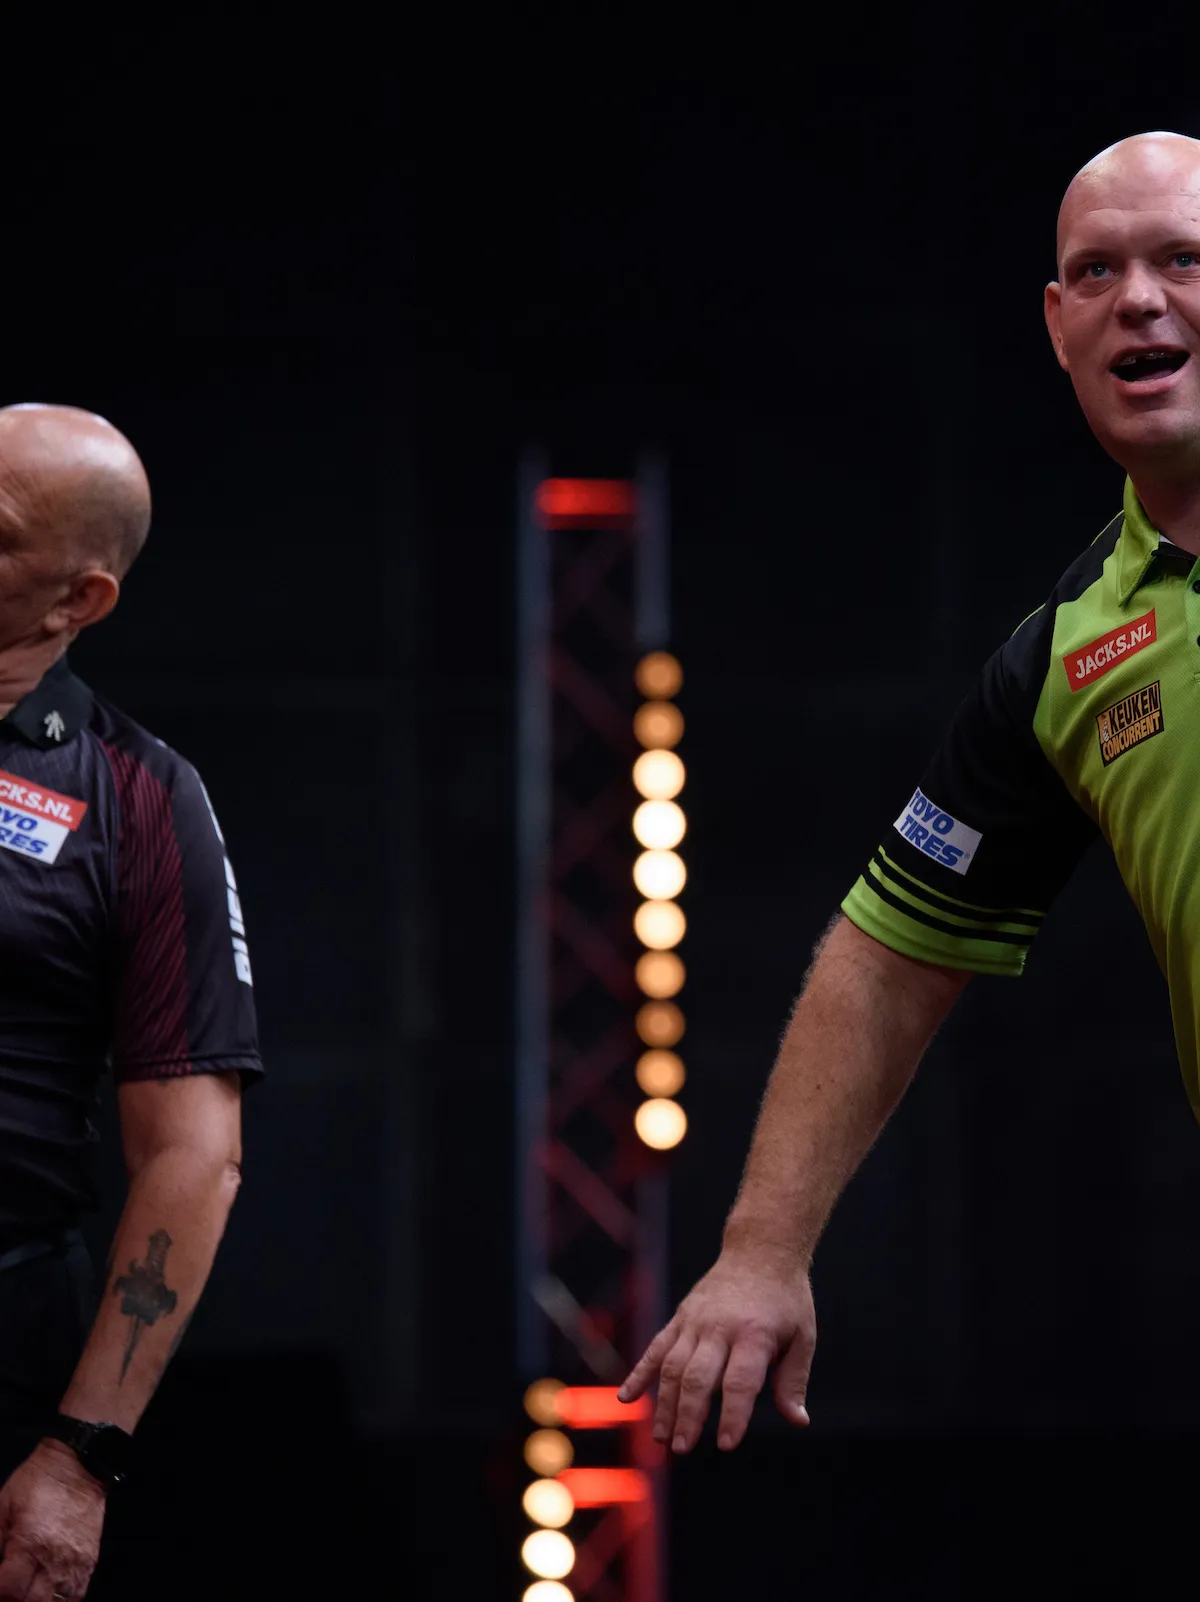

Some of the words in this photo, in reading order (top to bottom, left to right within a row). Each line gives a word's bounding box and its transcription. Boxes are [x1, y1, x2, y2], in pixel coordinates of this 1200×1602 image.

[1074, 623, 1152, 680] JACKS.NL
[1108, 684, 1159, 735] KEUKEN
[1102, 711, 1160, 761] CONCURRENT
[0, 806, 38, 831] YO
[908, 789, 955, 835] TOYO
[899, 814, 964, 867] TIRES
